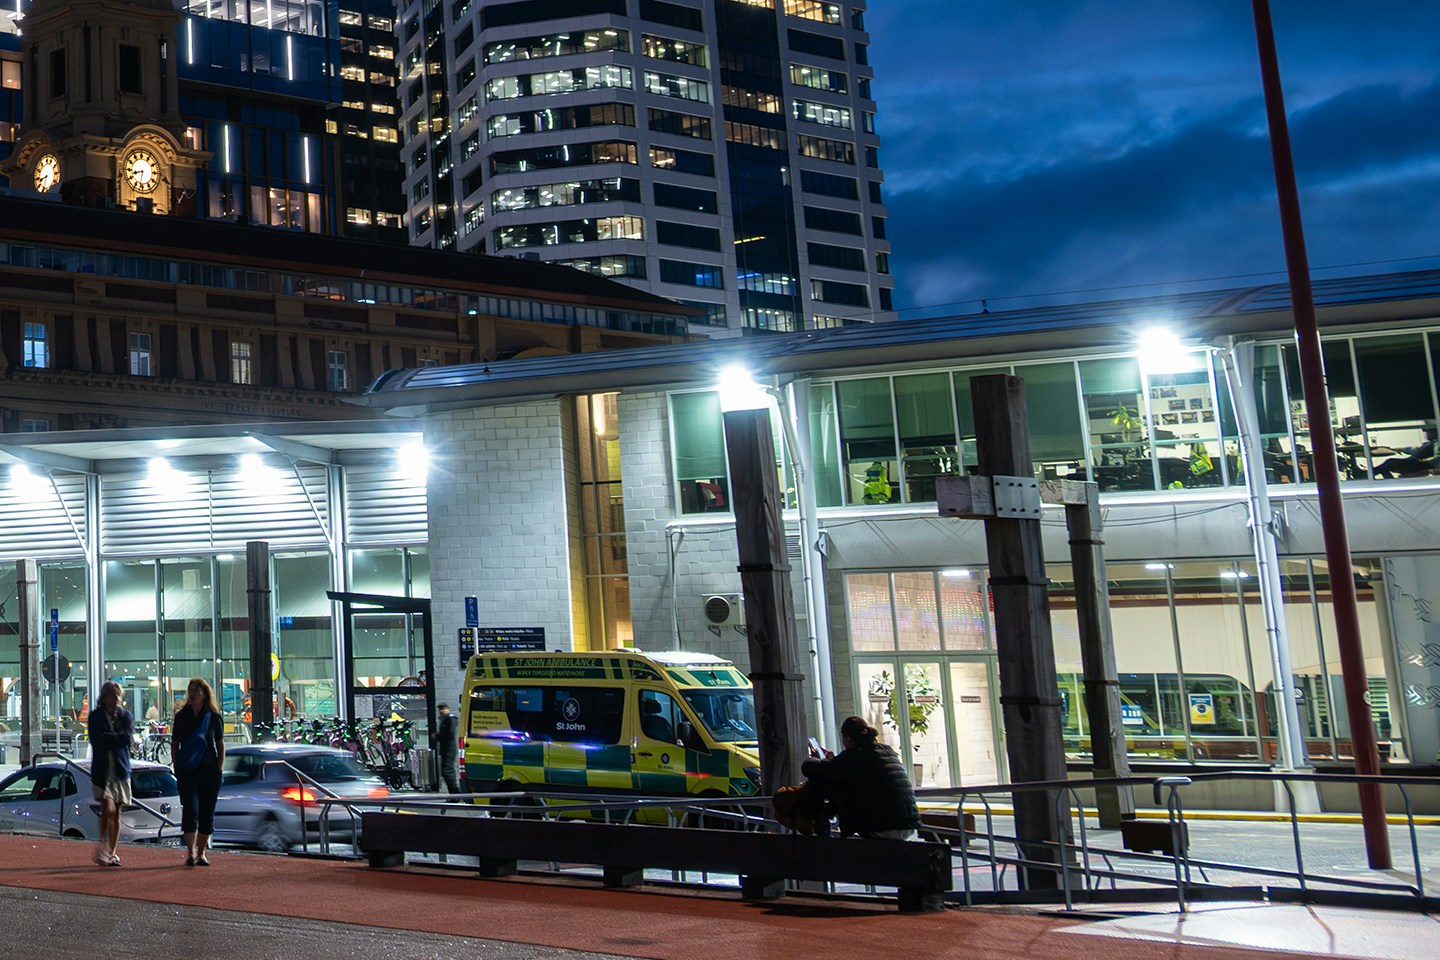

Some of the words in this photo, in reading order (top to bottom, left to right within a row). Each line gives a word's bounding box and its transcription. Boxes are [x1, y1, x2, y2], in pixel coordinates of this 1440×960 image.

[524, 658, 545, 667] JOHN
[546, 658, 597, 667] AMBULANCE
[556, 722, 565, 730] St
[565, 722, 586, 731] John
